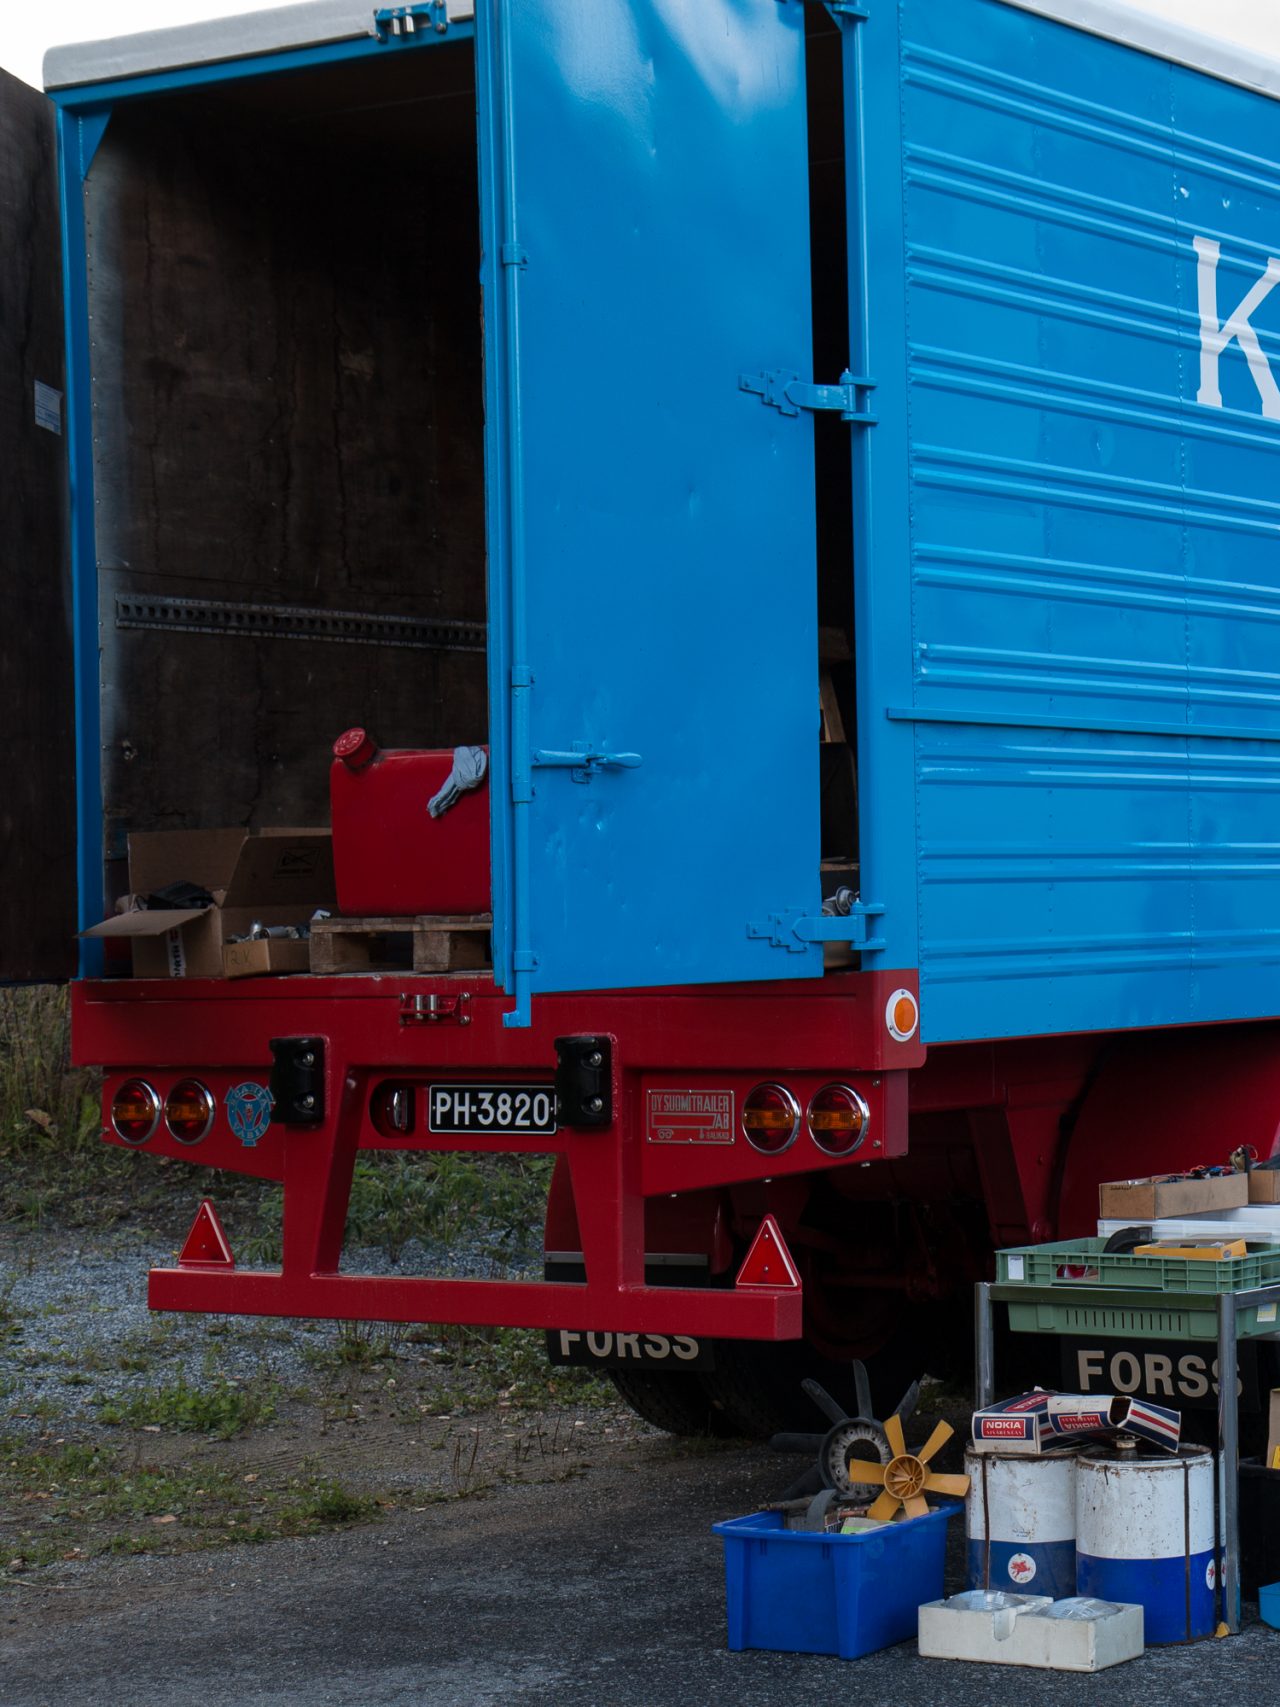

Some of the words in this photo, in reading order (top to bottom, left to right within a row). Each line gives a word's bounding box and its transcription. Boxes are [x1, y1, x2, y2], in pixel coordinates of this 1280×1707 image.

[435, 1092, 550, 1126] PH-3820
[986, 1421, 1022, 1430] NOKIA
[1063, 1421, 1099, 1432] NOKIA
